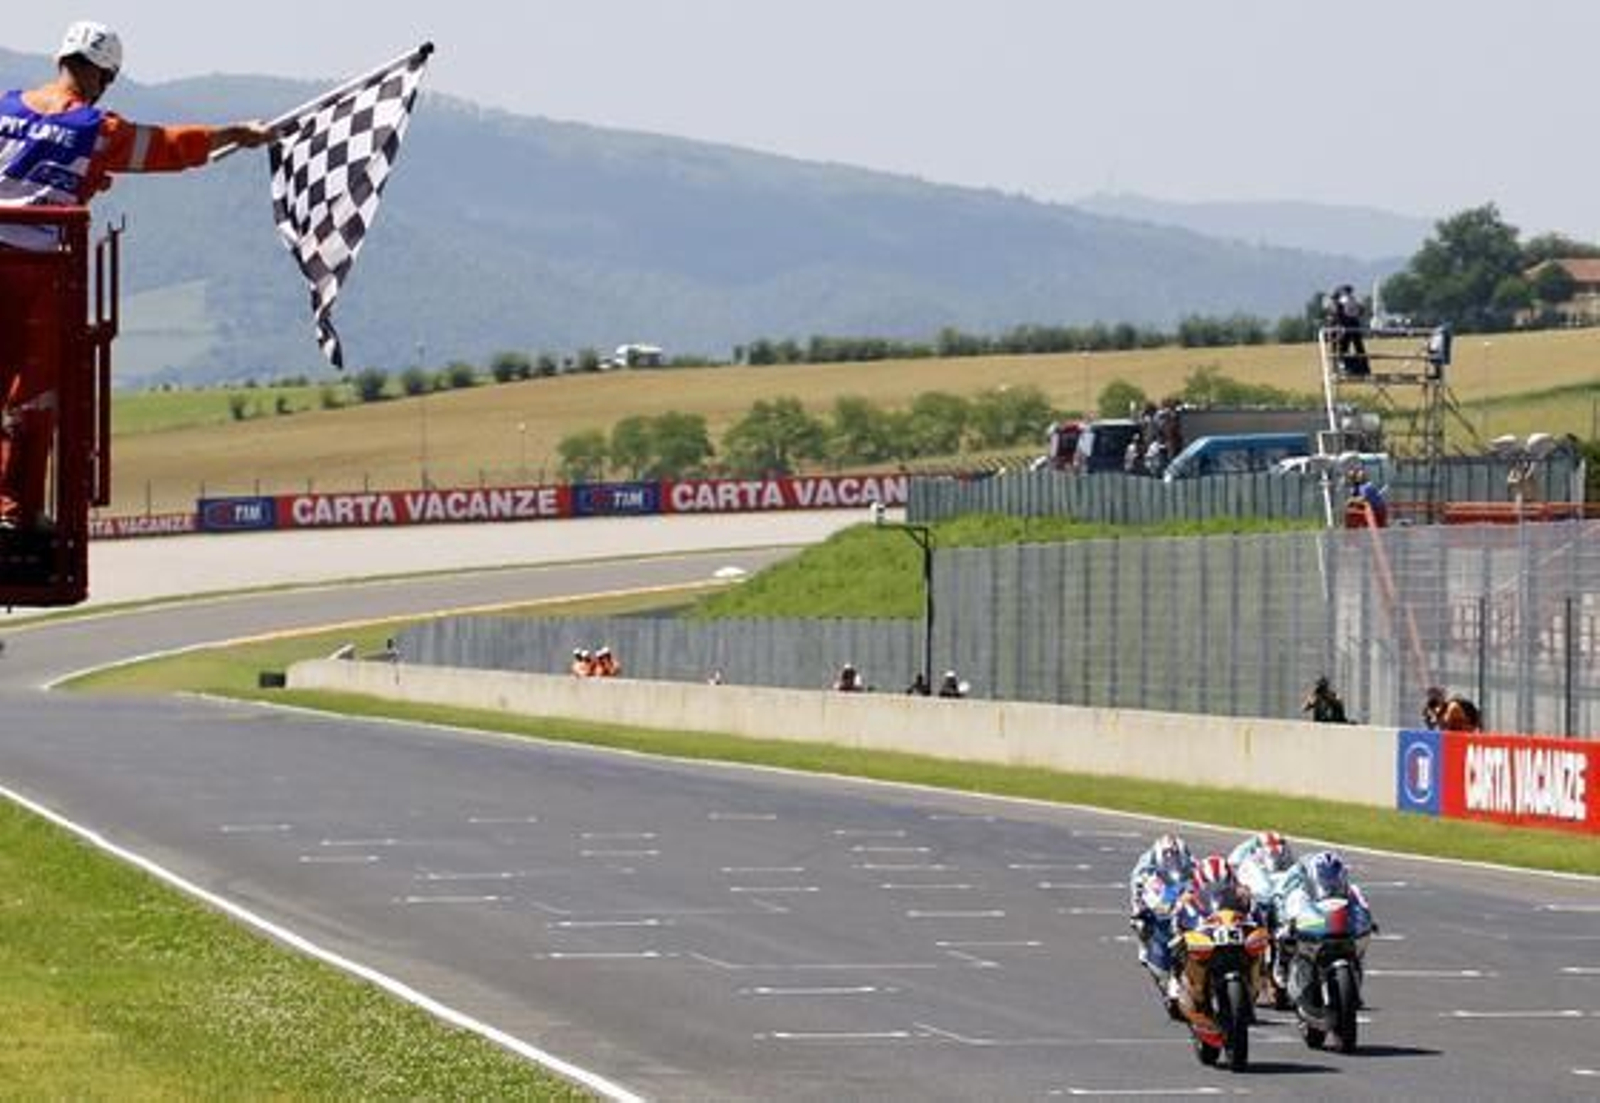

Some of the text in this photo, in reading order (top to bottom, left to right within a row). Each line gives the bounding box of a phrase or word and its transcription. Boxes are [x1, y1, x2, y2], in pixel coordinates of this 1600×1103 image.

[292, 488, 559, 525] CARTA VACANZE
[671, 474, 908, 511] CARTA VACAN
